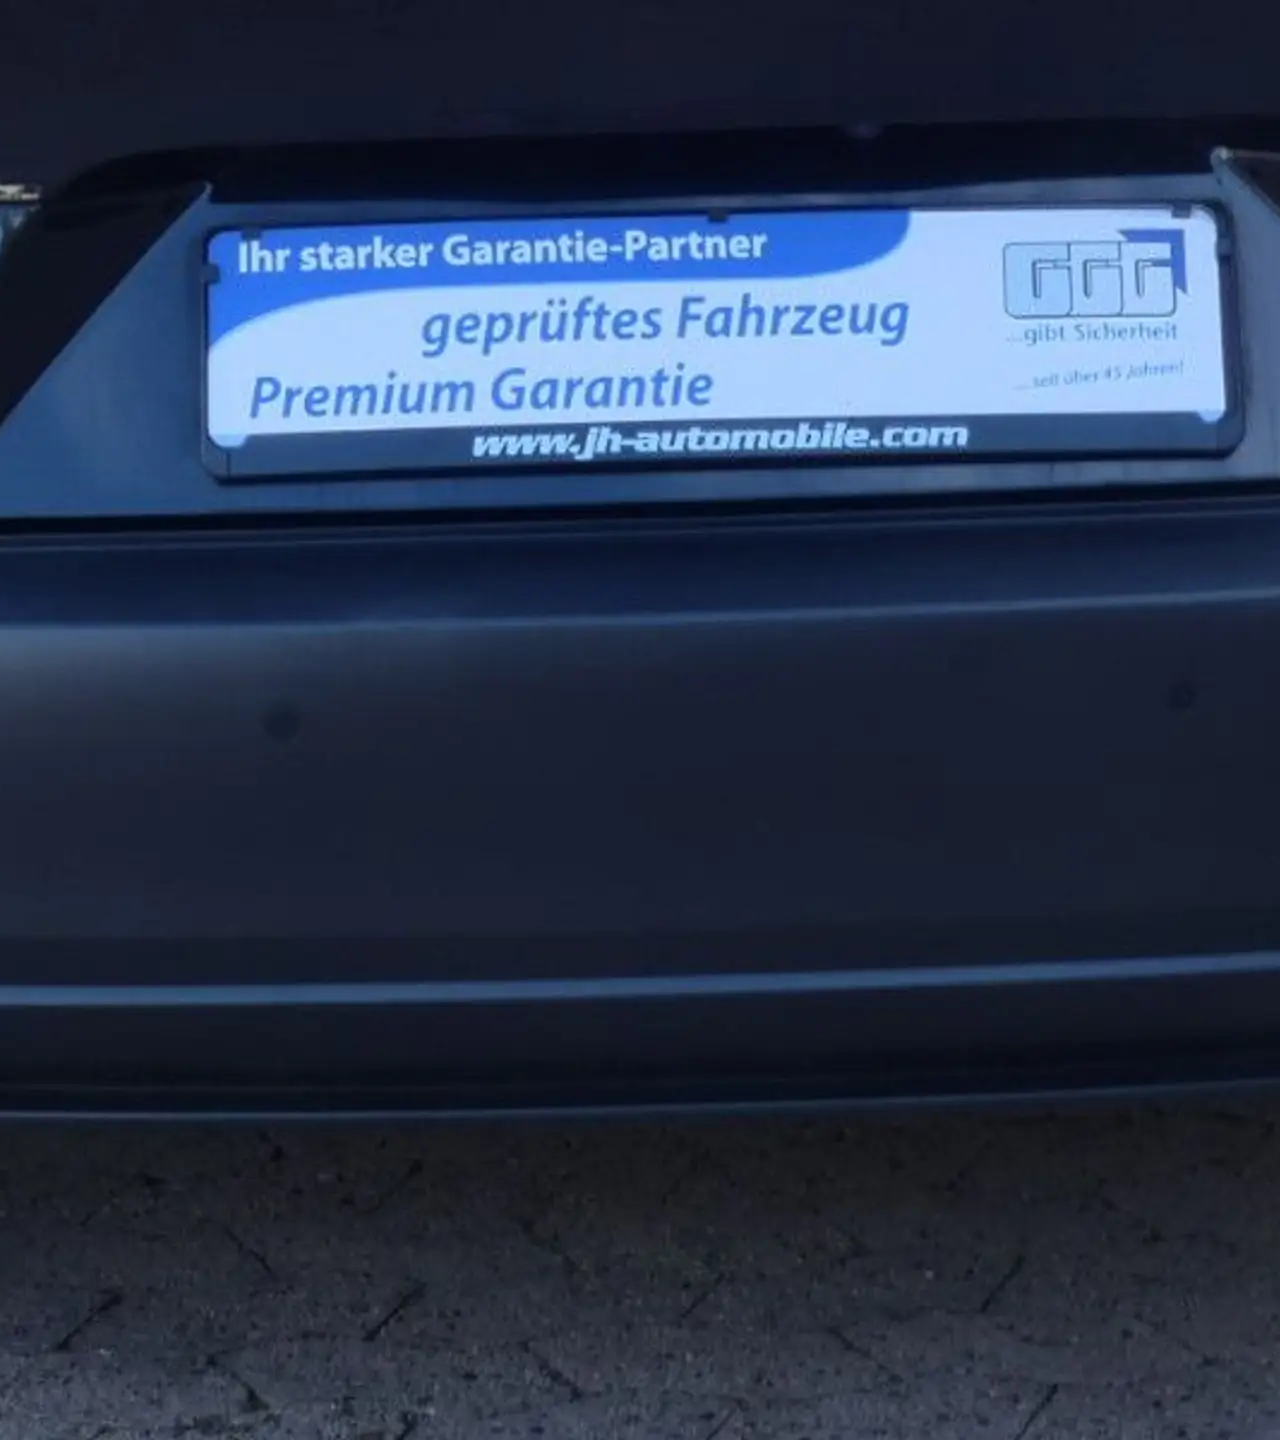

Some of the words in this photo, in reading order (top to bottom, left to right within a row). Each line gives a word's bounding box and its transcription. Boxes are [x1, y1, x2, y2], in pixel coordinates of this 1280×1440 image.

[238, 240, 291, 273] Ihr
[299, 235, 434, 272] starker
[442, 229, 768, 267] Garantie-Partner
[422, 296, 663, 358] geprüftes
[676, 292, 911, 347] Fahrzeug
[1074, 321, 1178, 343] Sicherheit
[249, 370, 476, 419] Premium
[491, 362, 714, 412] Garantie
[472, 421, 969, 461] www.jh-automobile.com
